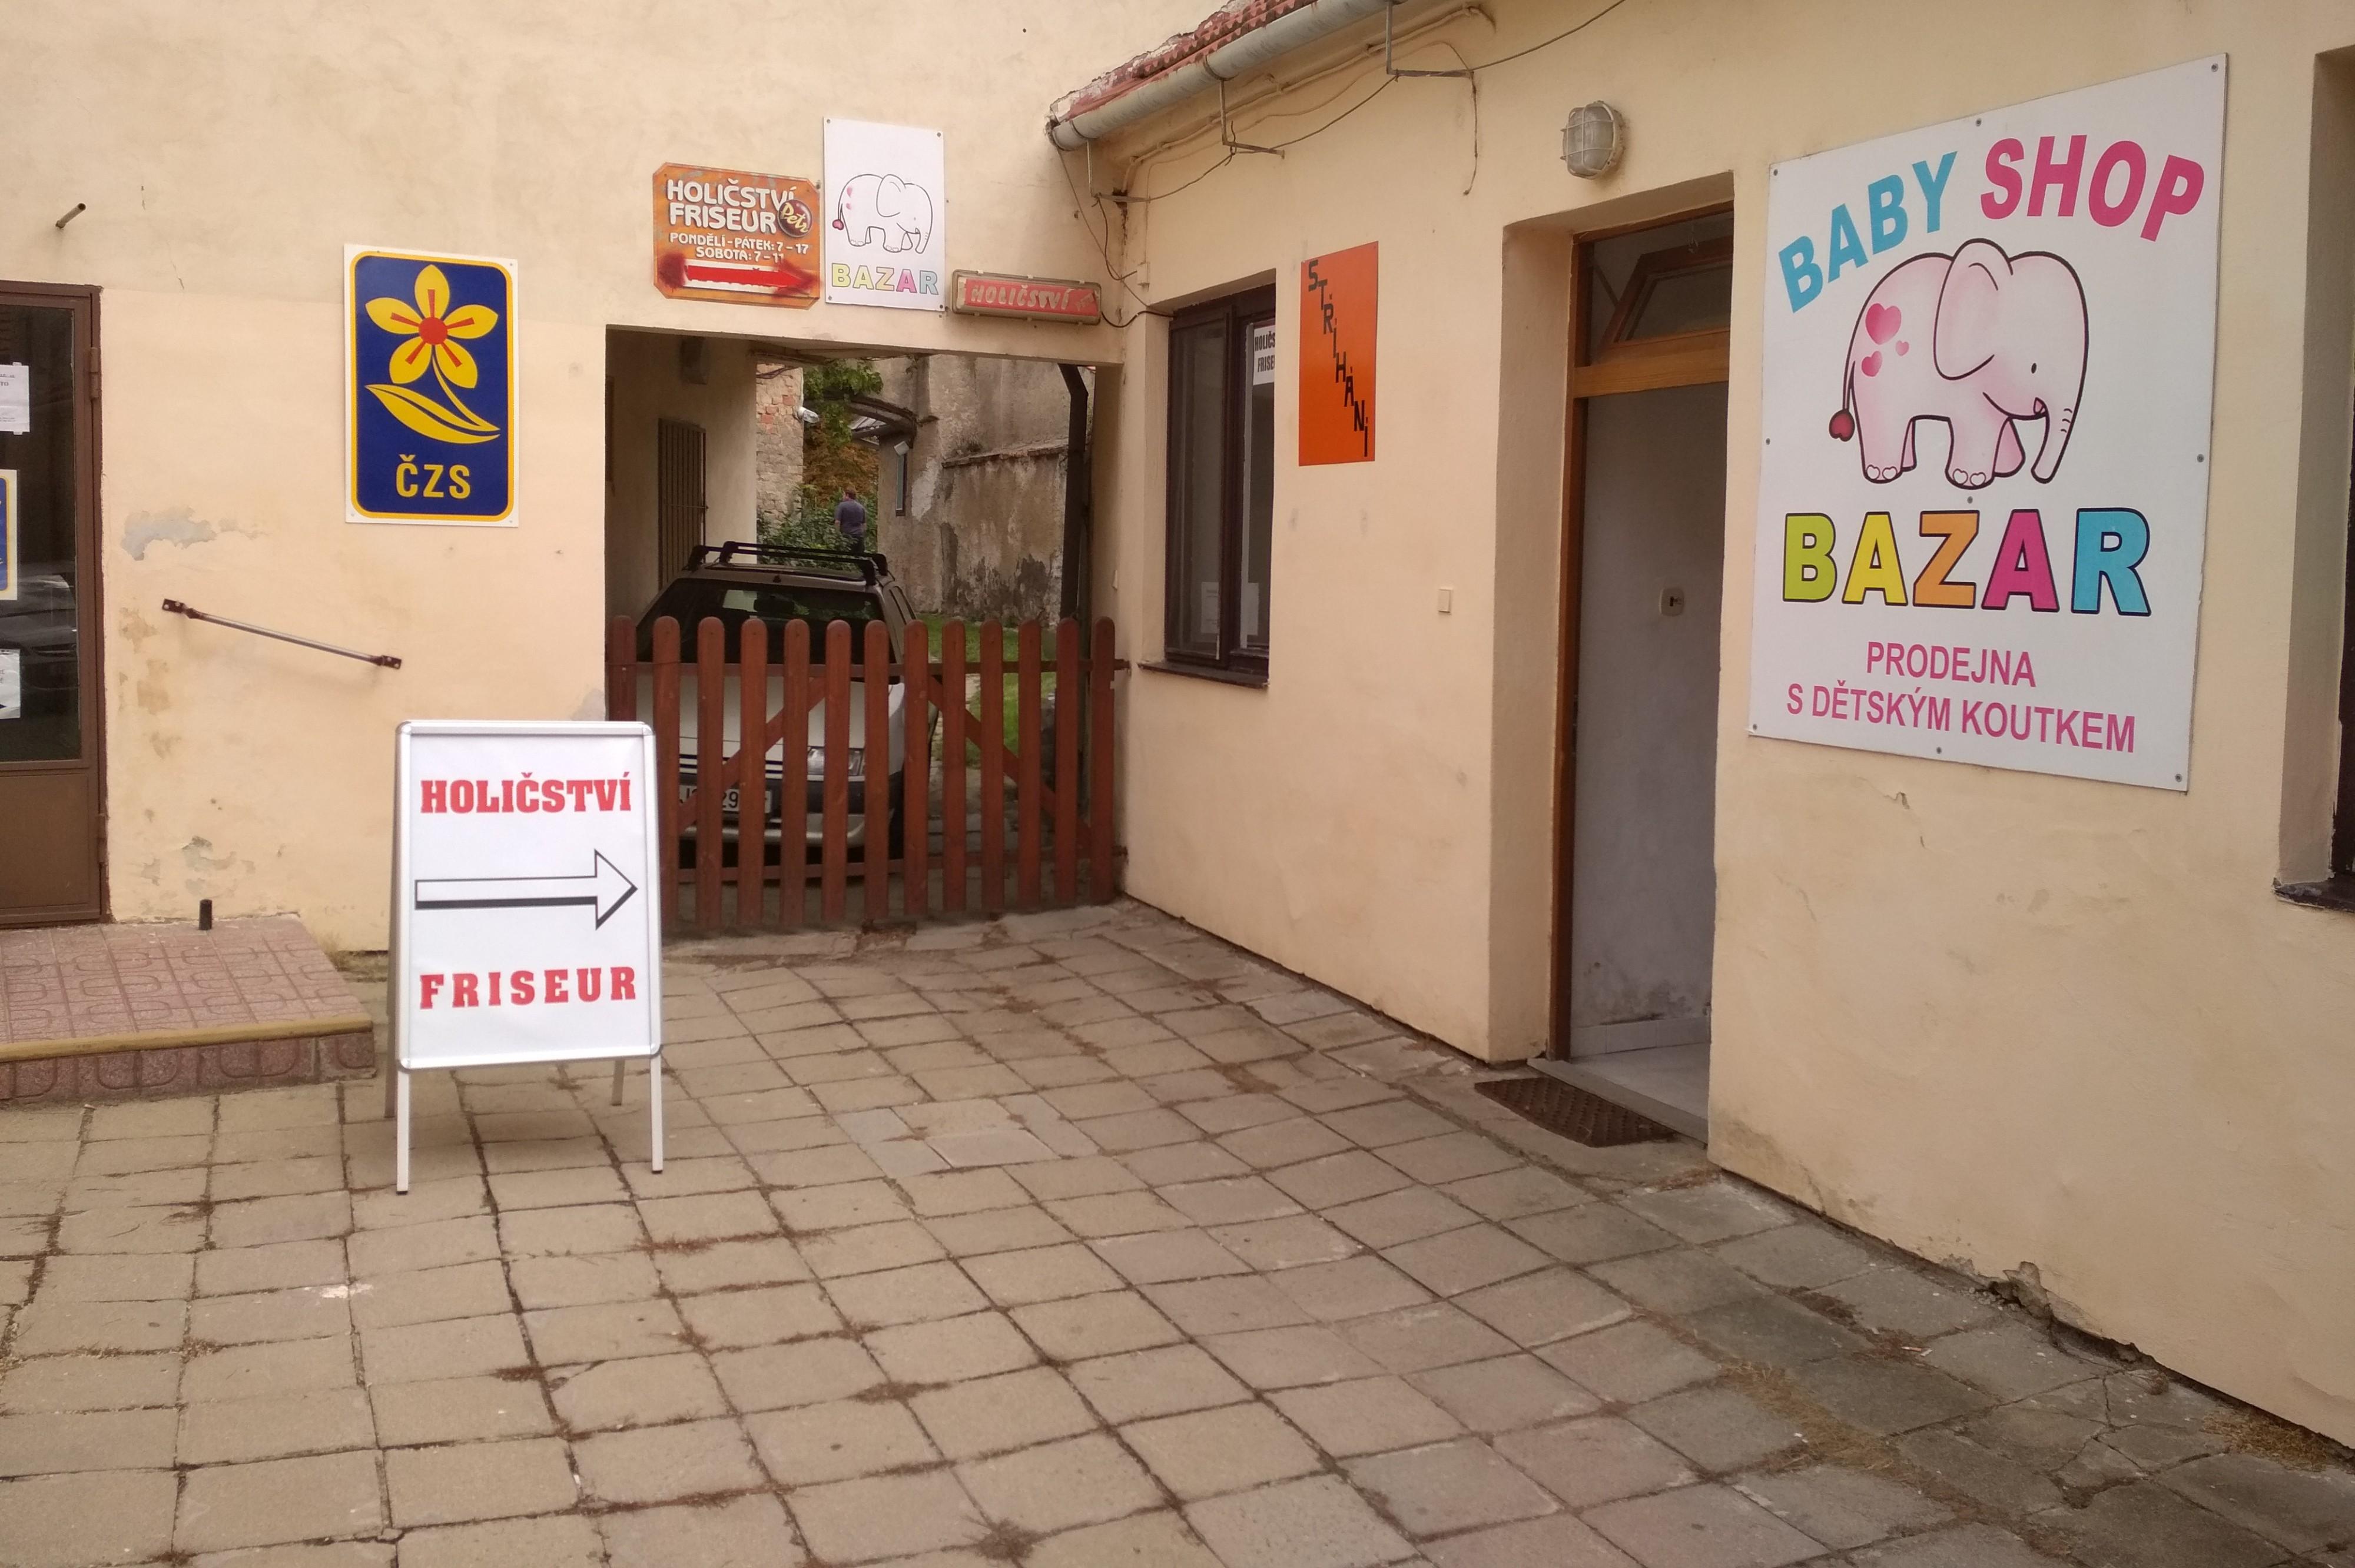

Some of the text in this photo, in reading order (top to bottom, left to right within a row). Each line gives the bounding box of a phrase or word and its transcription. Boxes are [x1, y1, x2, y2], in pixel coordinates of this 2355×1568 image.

[666, 177, 797, 211] HOLIČSTVÍ
[669, 202, 777, 234] FRISEUR
[780, 202, 809, 233] Petr
[1777, 134, 2205, 314] BABY SHOP
[669, 232, 726, 247] PONDĚLÍ
[734, 235, 775, 251] PÁTEK:
[776, 241, 784, 252] 7
[795, 243, 810, 254] 17
[695, 246, 752, 261] SOBOTA:
[754, 251, 761, 263] 7
[772, 253, 784, 264] 11
[831, 263, 940, 295] BAZAR
[971, 284, 1074, 310] HOLIČSTVÍ
[1257, 354, 1275, 373] FRISE
[396, 454, 471, 500] ČZS
[1782, 507, 2152, 617] BAZAR
[1866, 641, 2036, 688] PRODEJNA
[1786, 679, 2136, 753] S DĚTSKÝM KOUTKEM
[420, 772, 632, 814] HOLIČSTVÍ
[420, 966, 636, 1010] FRISEUR
